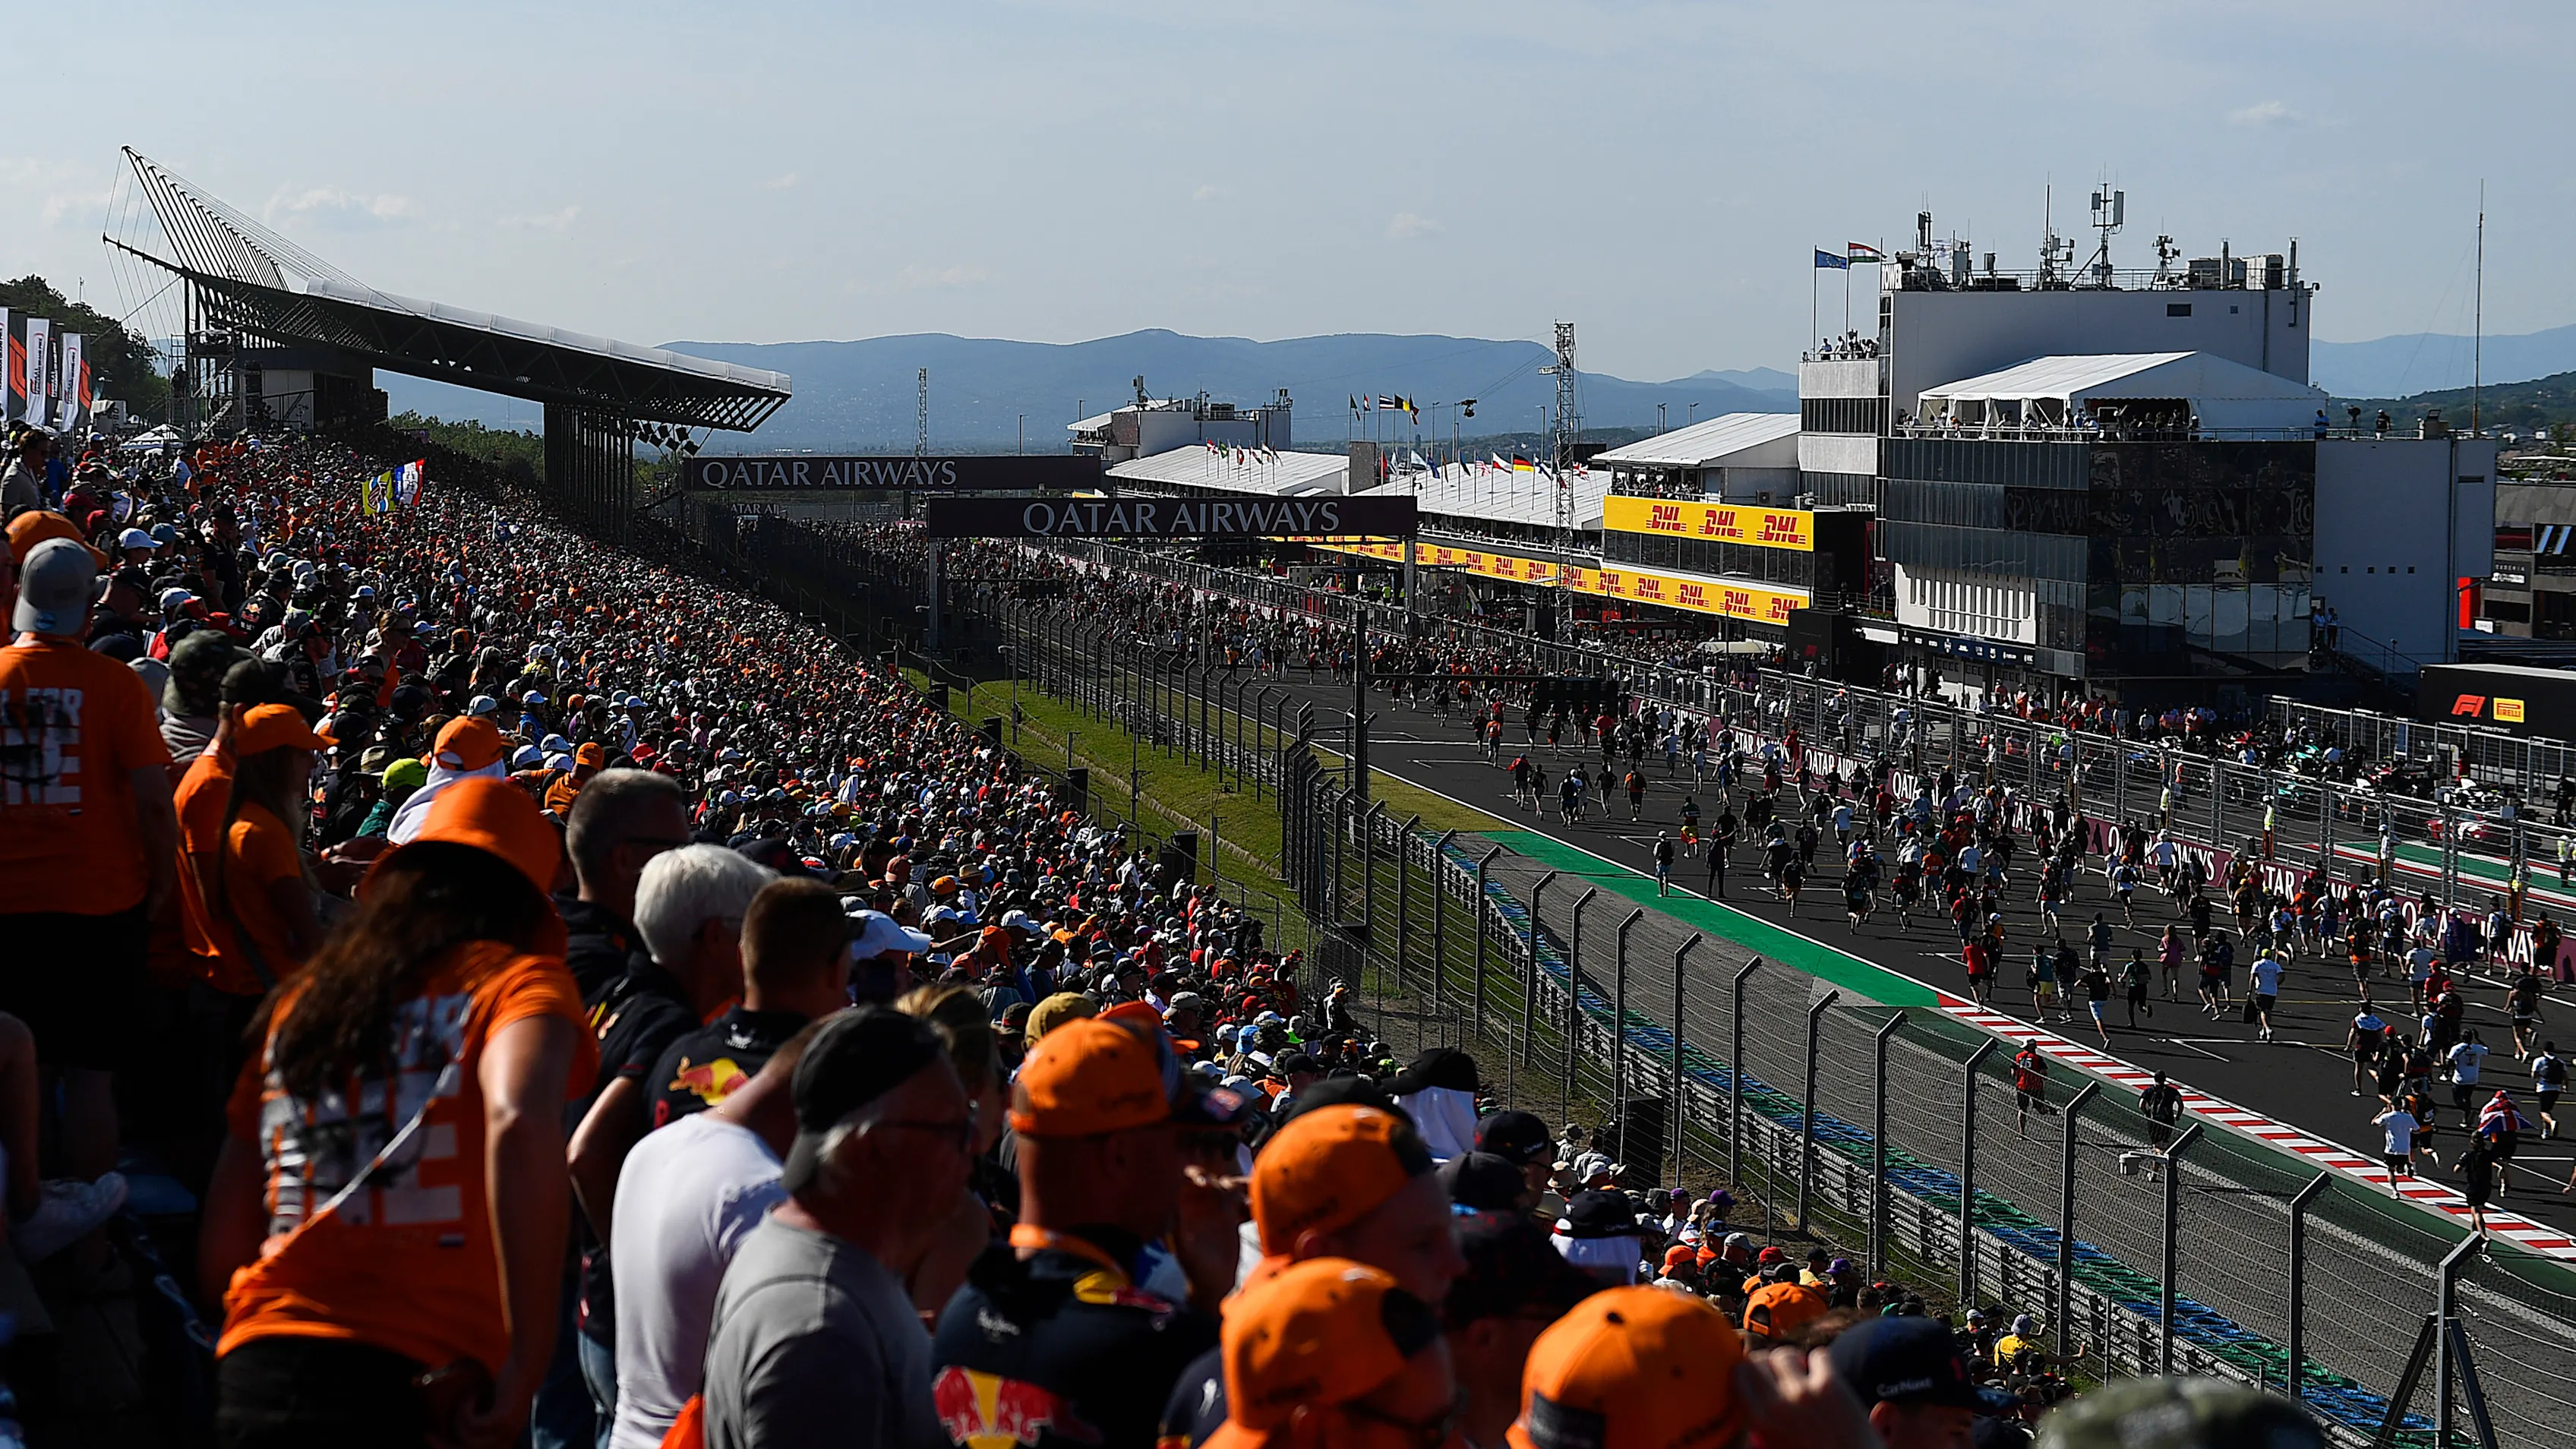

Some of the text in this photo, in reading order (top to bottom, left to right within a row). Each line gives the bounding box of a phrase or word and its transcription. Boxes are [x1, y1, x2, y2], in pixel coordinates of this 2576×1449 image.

[1881, 263, 1902, 289] TOWER
[702, 459, 958, 489] QATAR AIRWAYS
[731, 503, 761, 514] ATAR
[1022, 501, 1340, 536] QATAR AIRWAYS
[1651, 504, 1799, 544] DHL DHL DHL
[1495, 556, 1516, 576] DHL
[1599, 572, 1622, 593] DHL
[1637, 577, 1661, 600] DHL
[1678, 584, 1706, 607] DHL
[1724, 590, 1752, 615] DHL
[2451, 693, 2486, 718] F1
[2496, 702, 2521, 718] PIRELLI
